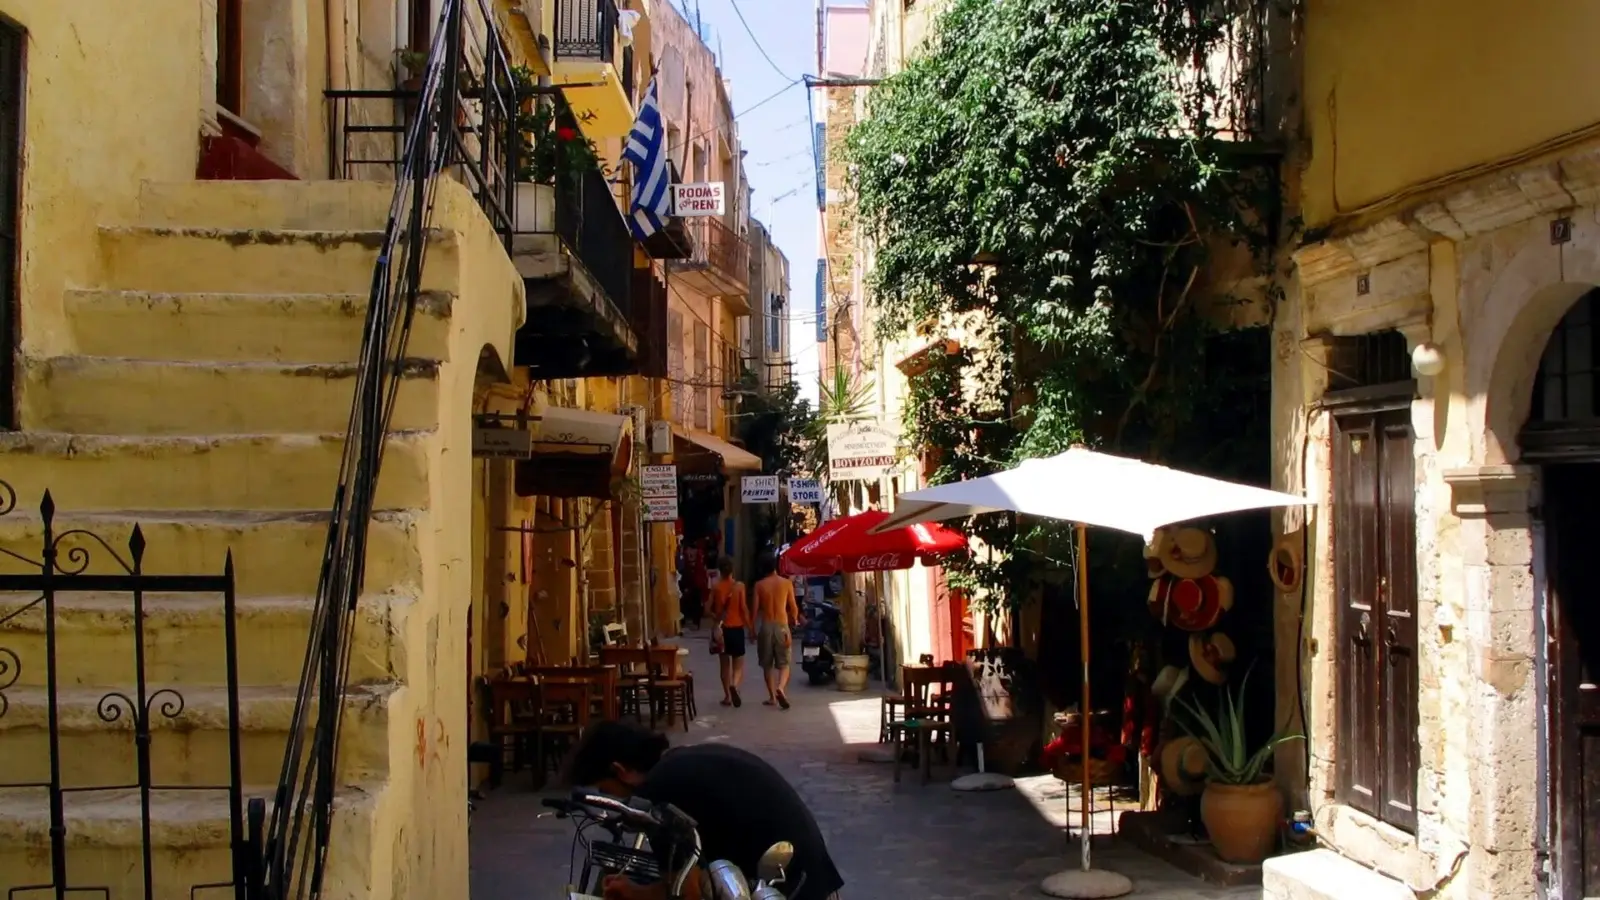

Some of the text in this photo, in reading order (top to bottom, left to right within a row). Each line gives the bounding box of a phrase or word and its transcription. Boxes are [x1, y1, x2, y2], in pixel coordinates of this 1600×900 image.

[679, 187, 720, 198] ROOMS
[692, 199, 720, 210] RENT
[793, 491, 819, 500] STORE
